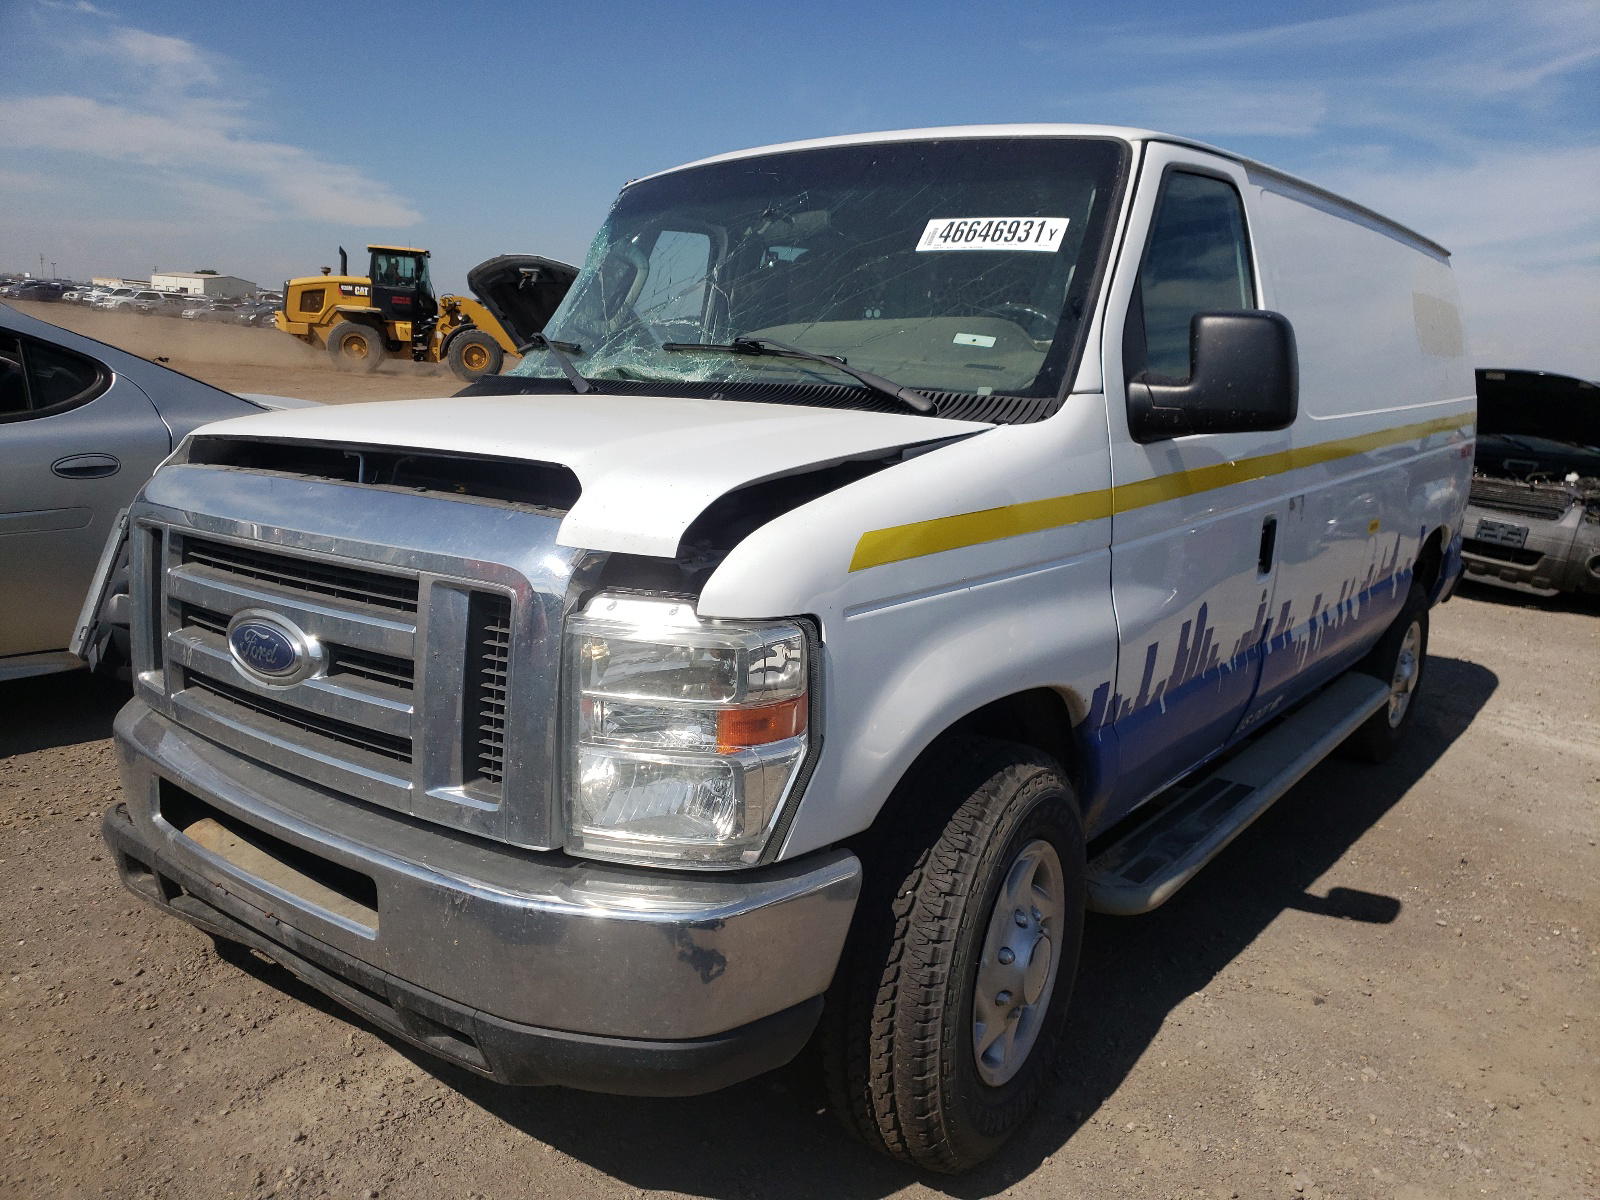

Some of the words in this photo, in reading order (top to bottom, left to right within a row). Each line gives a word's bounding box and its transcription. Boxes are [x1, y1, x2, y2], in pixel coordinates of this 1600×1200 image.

[939, 220, 1047, 244] 46646931
[1048, 228, 1059, 242] Y
[354, 286, 369, 296] CAT
[239, 628, 279, 664] Ford
